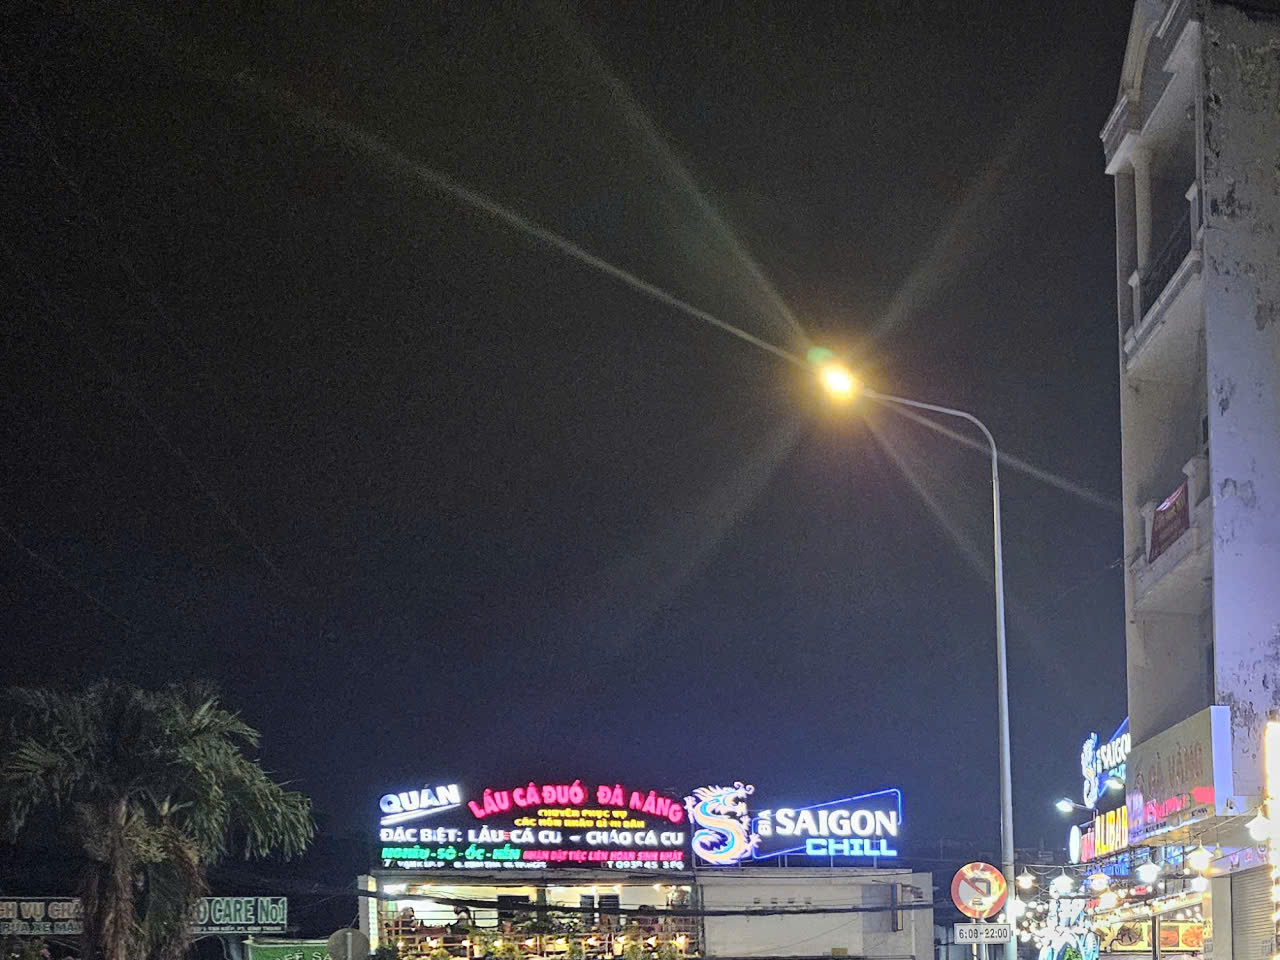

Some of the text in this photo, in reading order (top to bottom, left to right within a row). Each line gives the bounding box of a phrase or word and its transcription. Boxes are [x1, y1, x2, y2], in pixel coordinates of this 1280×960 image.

[775, 808, 898, 837] SAIGON
[380, 826, 418, 843] ĐẶC
[420, 827, 463, 844] BIỆT:
[510, 827, 535, 843] CÁ
[586, 829, 632, 845] CHÁO
[806, 838, 898, 856] CHILL
[211, 898, 255, 924] CARE
